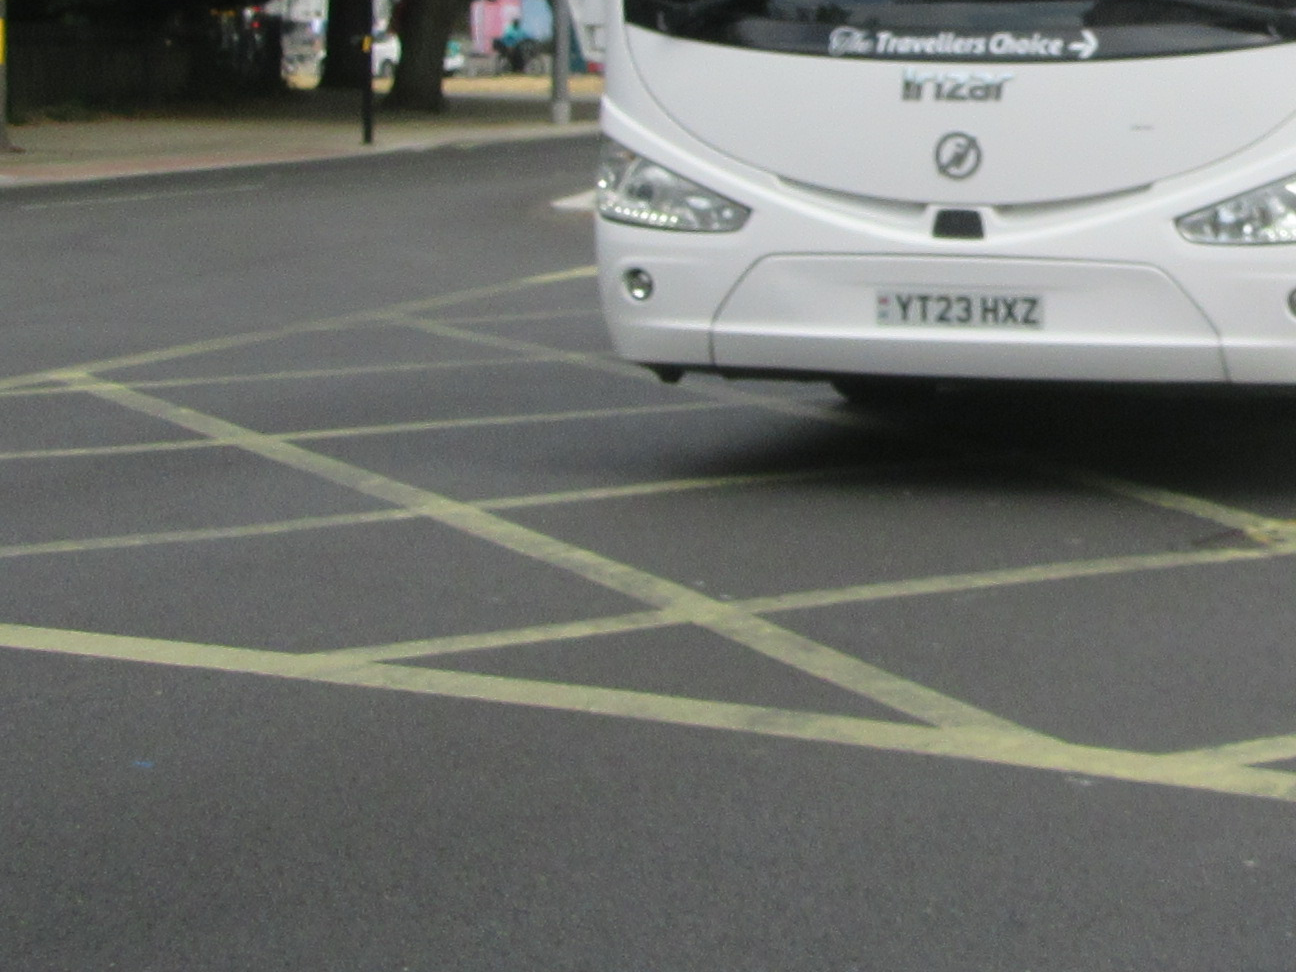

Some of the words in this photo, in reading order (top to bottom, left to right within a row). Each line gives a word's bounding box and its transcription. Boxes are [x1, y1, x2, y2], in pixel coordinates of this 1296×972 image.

[876, 31, 986, 55] Travellers
[988, 32, 1064, 56] Choice
[896, 294, 972, 324] YT23
[980, 296, 1042, 325] HXZ
